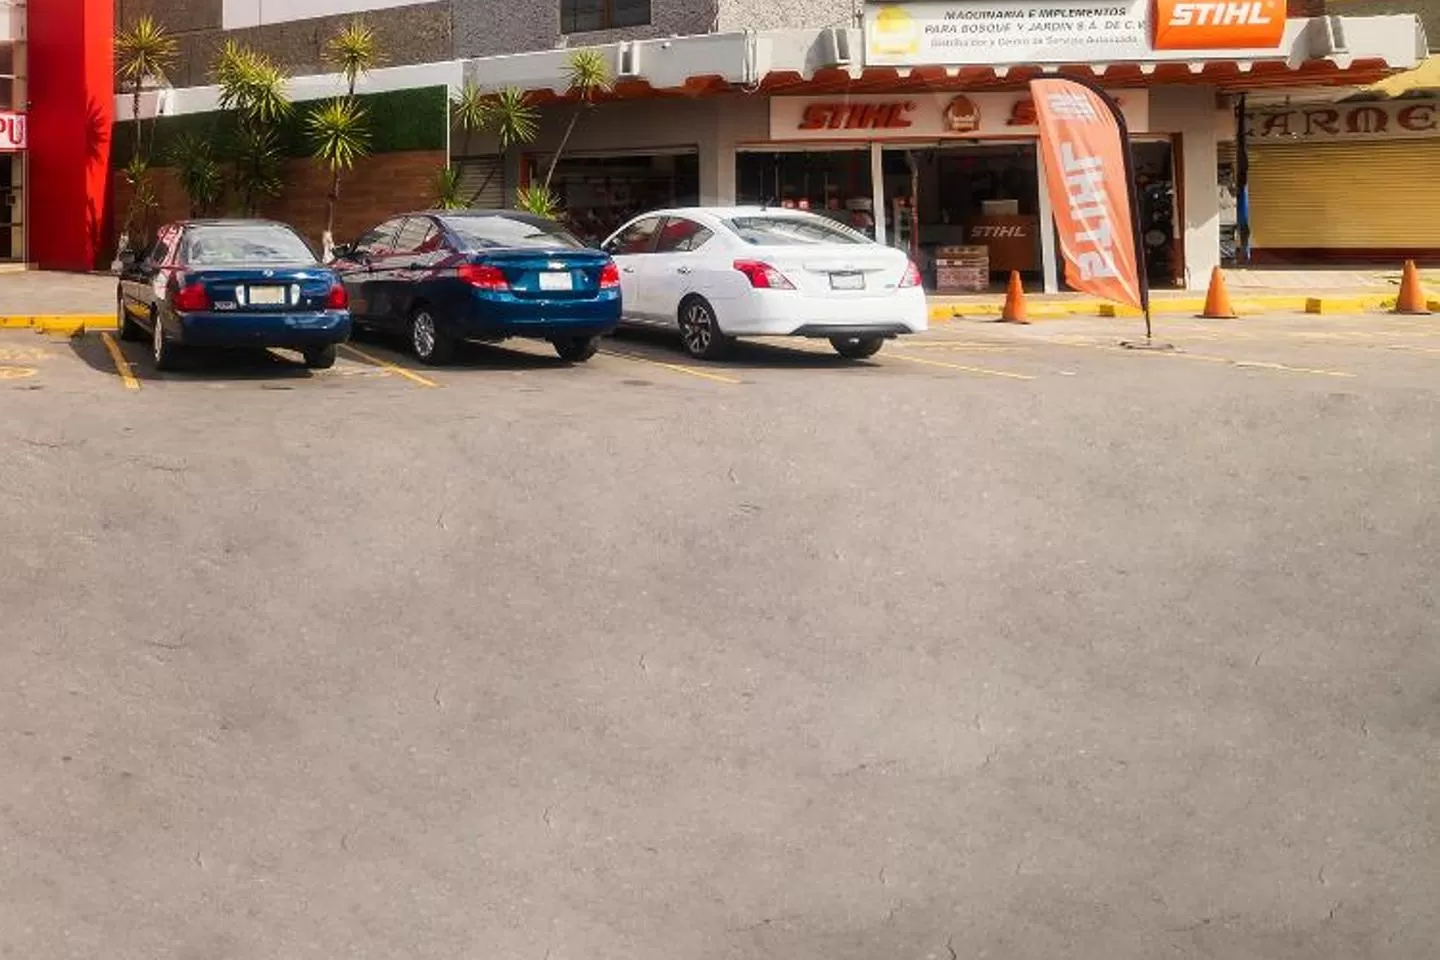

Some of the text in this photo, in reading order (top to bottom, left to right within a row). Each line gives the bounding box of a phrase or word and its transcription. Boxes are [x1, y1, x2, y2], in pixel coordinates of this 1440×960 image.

[943, 8, 1025, 21] MAQUINARIA
[1039, 7, 1127, 19] IMPLEMENTOS
[1168, 1, 1272, 26] STIHL
[924, 23, 958, 34] PARA
[798, 103, 912, 129] STIHL
[1061, 142, 1117, 281] STIHL
[971, 225, 1027, 237] STIHL
